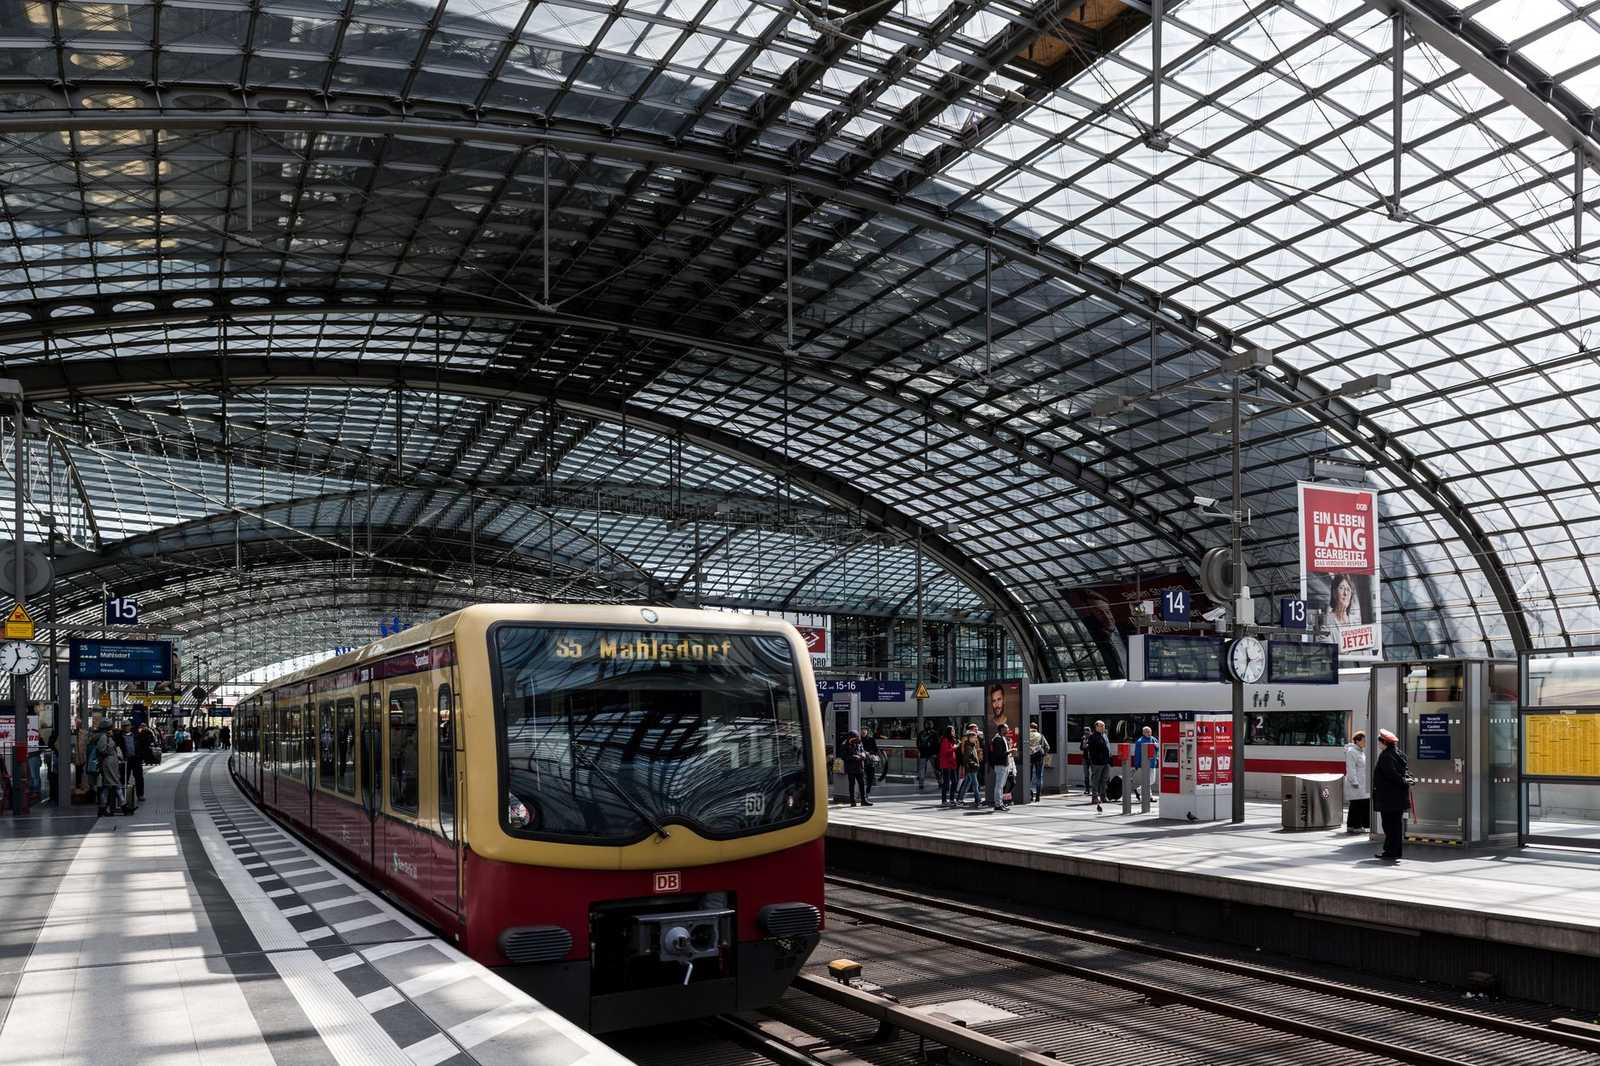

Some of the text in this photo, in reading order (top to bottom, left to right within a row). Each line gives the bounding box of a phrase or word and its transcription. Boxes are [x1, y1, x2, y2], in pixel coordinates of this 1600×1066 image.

[1313, 511, 1365, 529] EIN LEBEN
[1313, 525, 1367, 551] LANG
[110, 599, 137, 618] 15
[1165, 591, 1185, 614] 14
[1288, 600, 1305, 622] 13
[556, 637, 732, 660] S5 Mahlsdorf
[1342, 632, 1374, 649] JETZT!
[835, 680, 856, 690] 15-16
[1255, 715, 1264, 729] 2
[658, 875, 677, 889] DB
